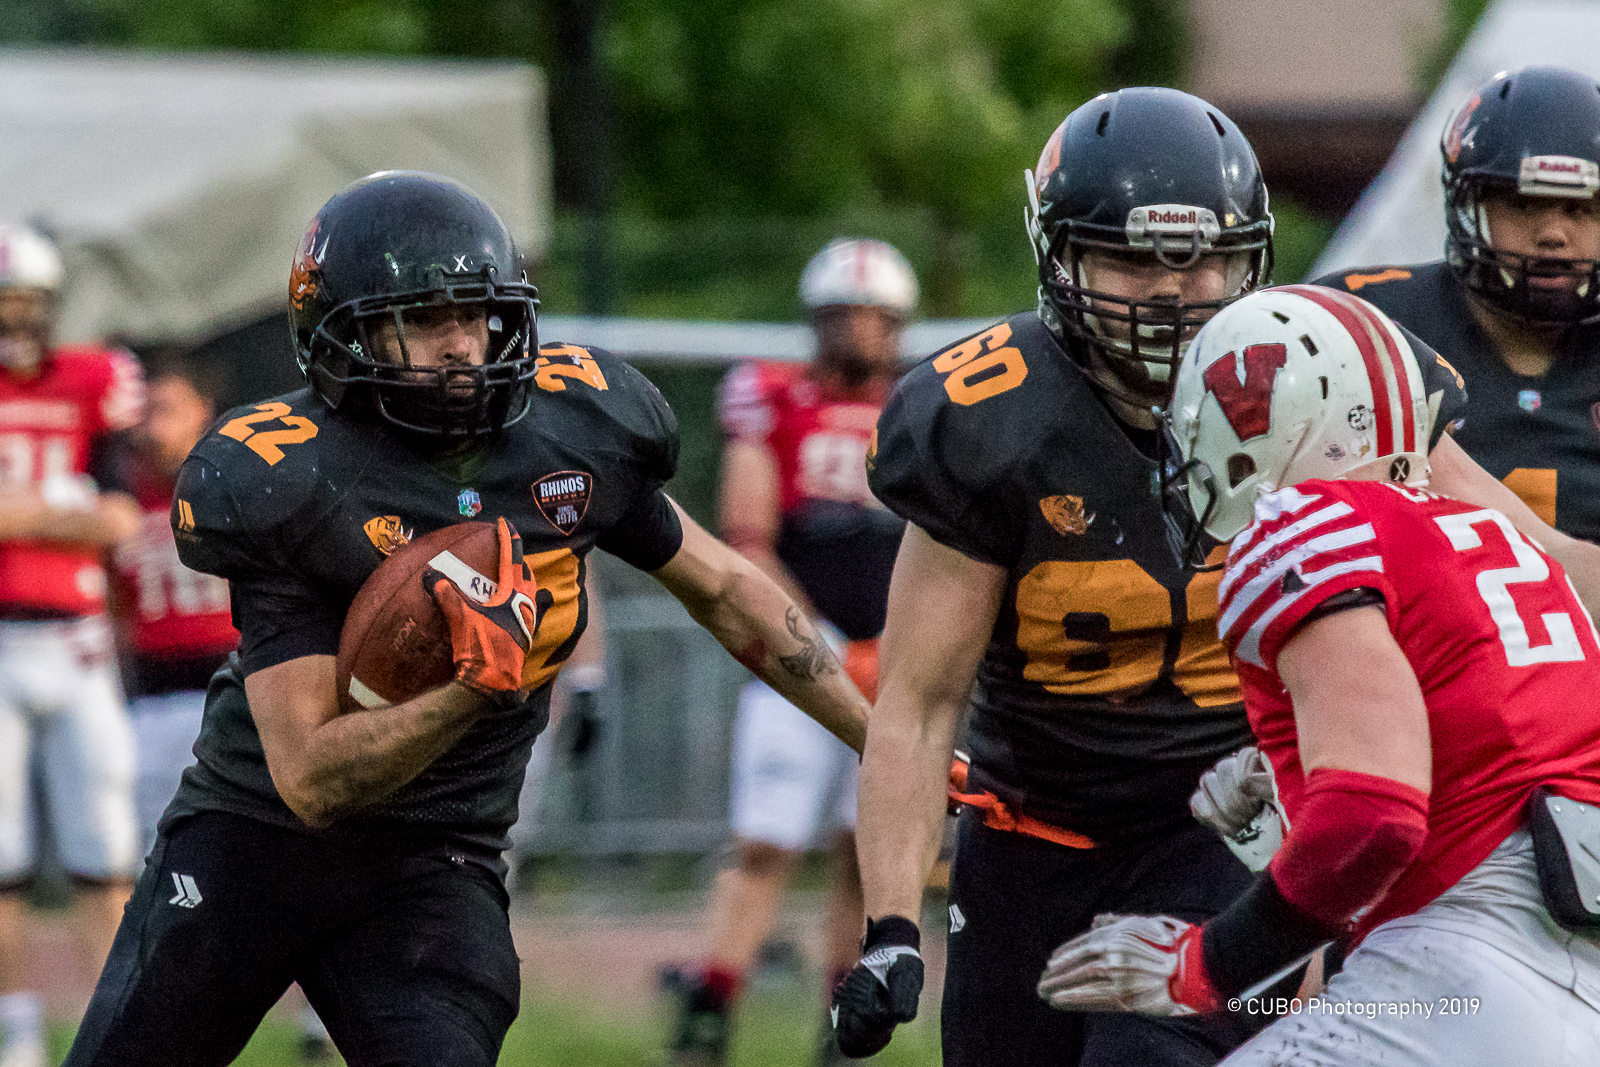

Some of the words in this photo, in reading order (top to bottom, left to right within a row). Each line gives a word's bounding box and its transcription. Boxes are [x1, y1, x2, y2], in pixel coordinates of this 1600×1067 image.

[1148, 209, 1197, 224] Riddell
[931, 322, 1029, 407] 60
[1202, 343, 1288, 443] V
[218, 401, 319, 467] 22
[540, 475, 585, 497] RHINOS
[555, 510, 578, 525] 1978
[470, 575, 498, 599] RH
[1433, 508, 1600, 667] 2
